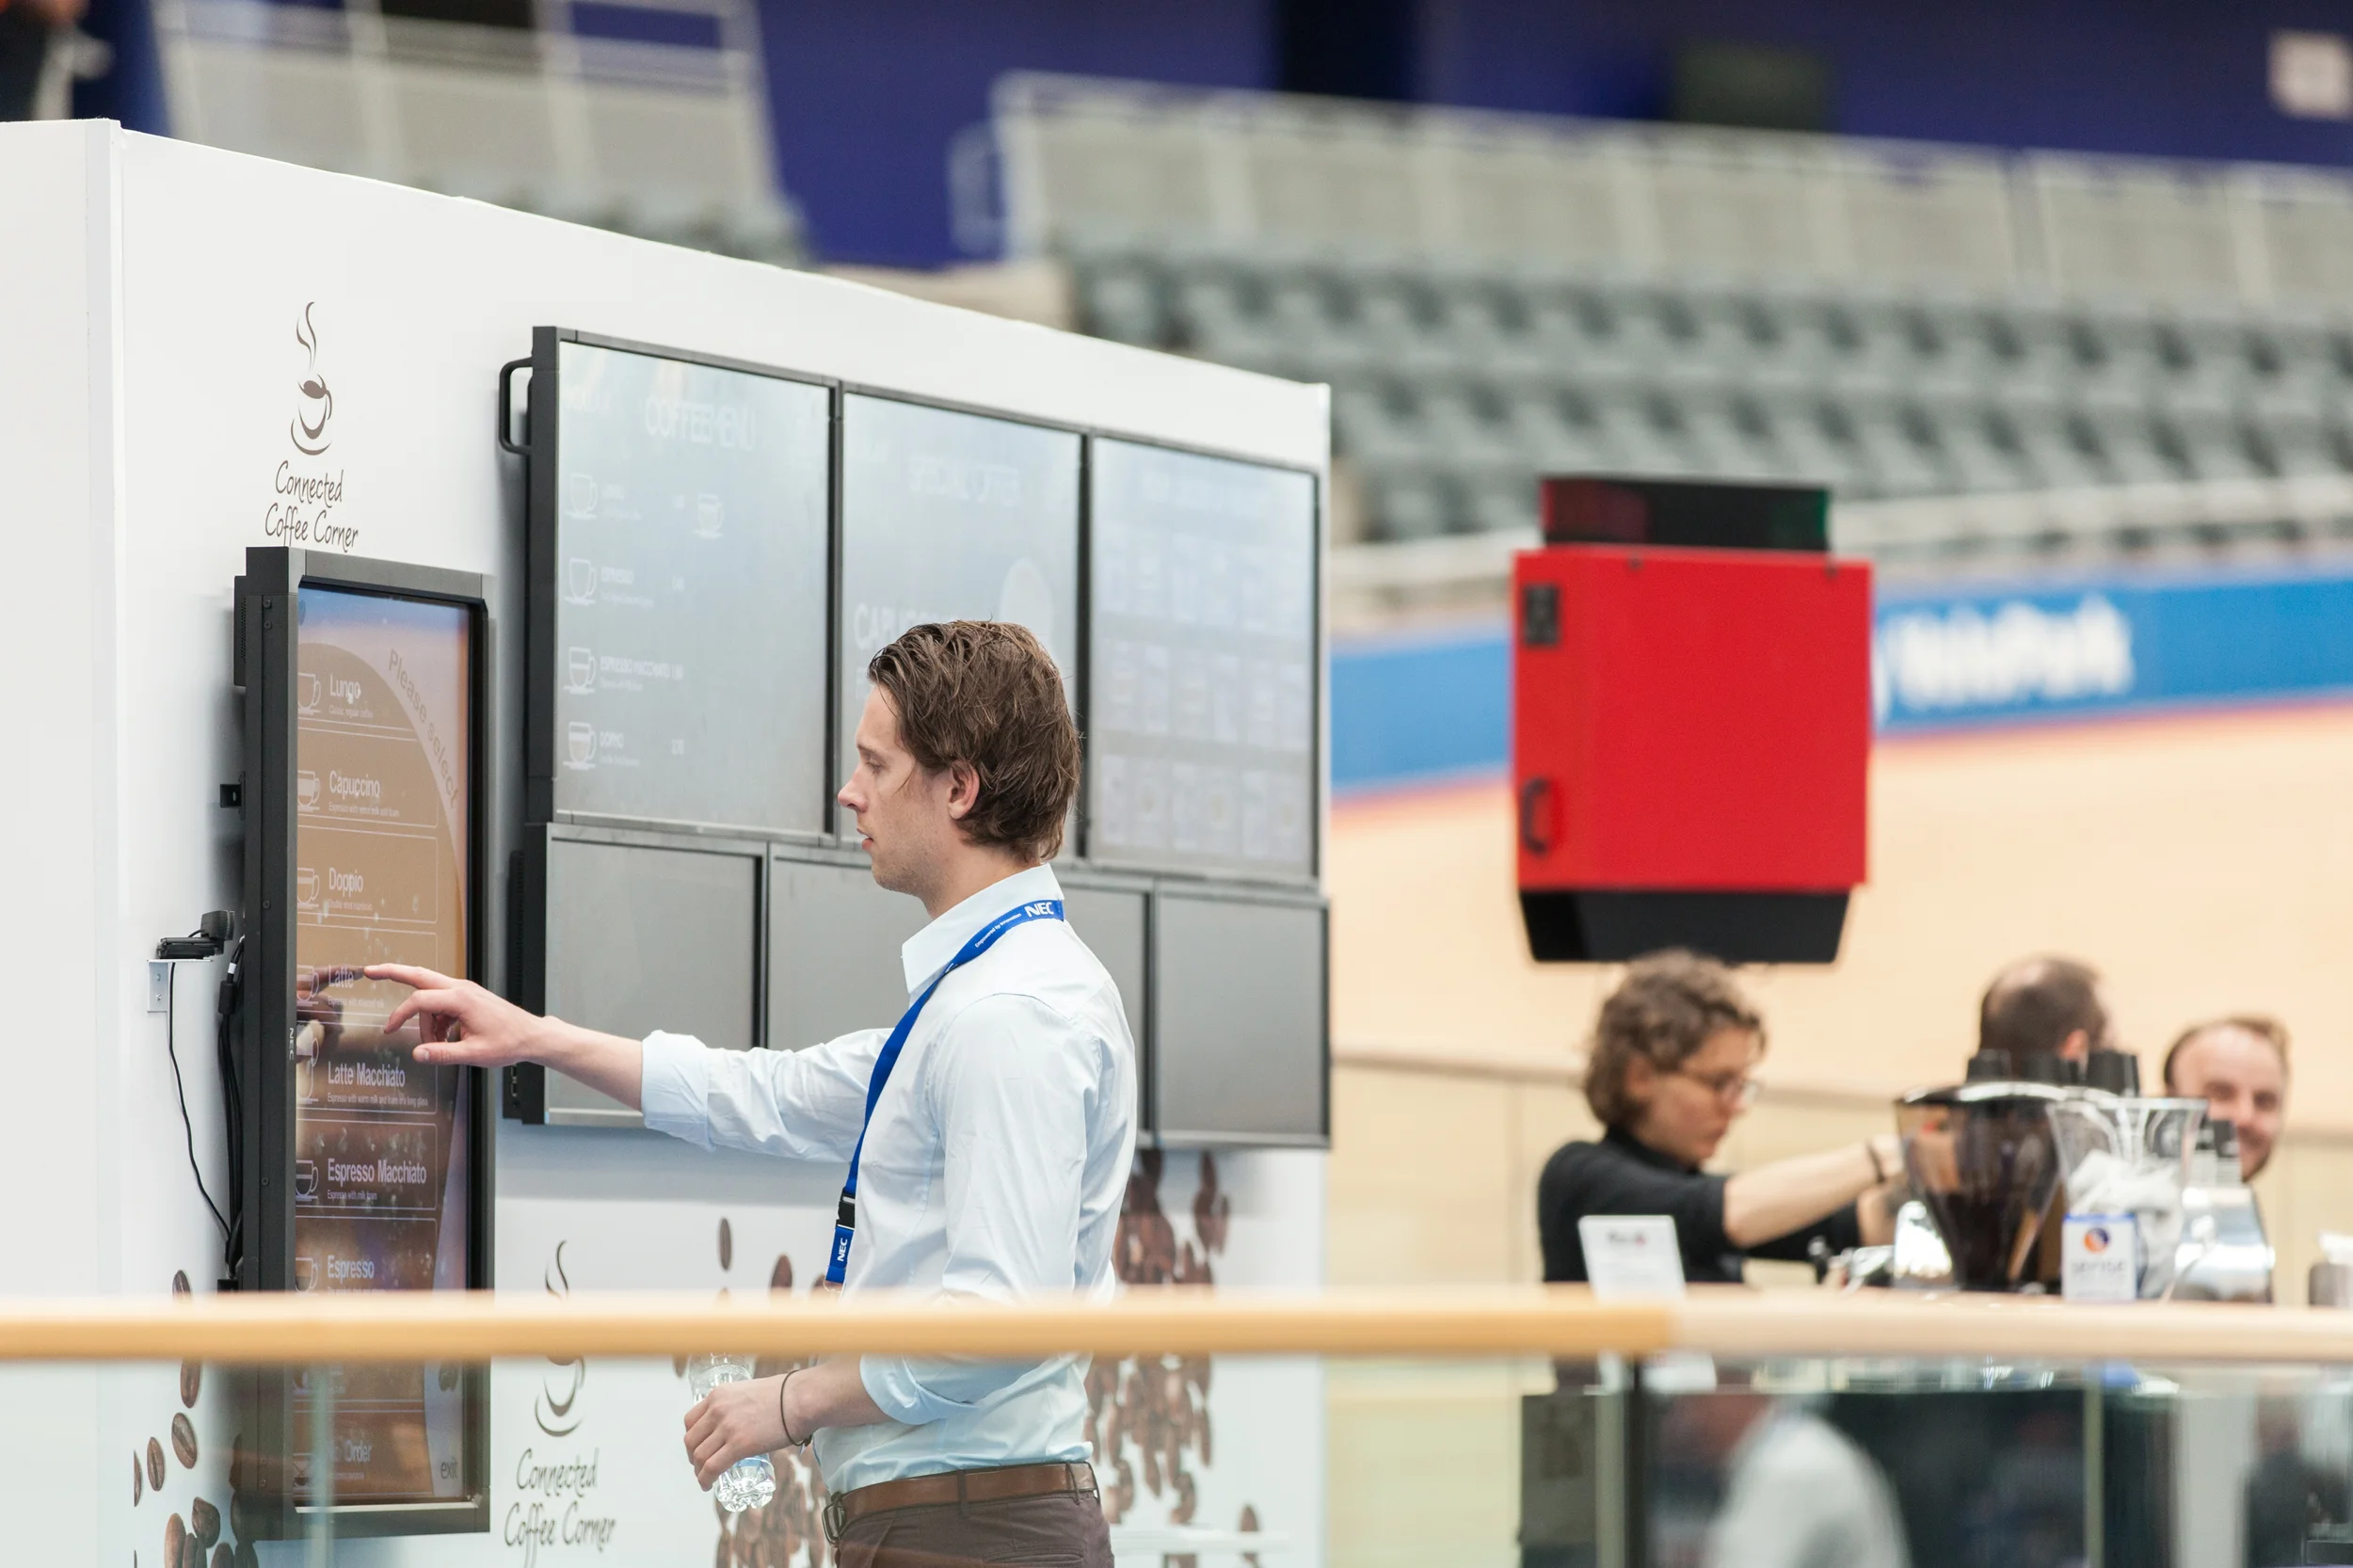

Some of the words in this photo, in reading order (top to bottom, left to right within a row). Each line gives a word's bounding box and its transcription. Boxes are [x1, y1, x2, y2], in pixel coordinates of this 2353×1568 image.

[275, 459, 344, 508] Connected
[264, 502, 309, 546] Coffee
[313, 509, 359, 552] Corner
[329, 672, 361, 704] Lungo
[389, 648, 427, 724] Please
[426, 722, 459, 809] select
[329, 770, 380, 800] Capuccino
[328, 867, 364, 898] Doppio
[1024, 902, 1054, 918] NEC
[328, 964, 354, 988] Latte
[328, 1061, 354, 1085] Latte
[357, 1062, 406, 1087] Macchiato
[327, 1092, 347, 1104] Espresso
[328, 1158, 375, 1187] Espresso
[377, 1159, 427, 1184] Macchiato
[327, 1189, 347, 1201] Espresso
[837, 1237, 848, 1262] NEC
[328, 1255, 375, 1284] Espresso
[344, 1439, 373, 1464] Order
[440, 1458, 459, 1480] exit
[516, 1447, 600, 1497] Connected
[504, 1501, 556, 1568] Coffee
[562, 1500, 616, 1554] Corner
